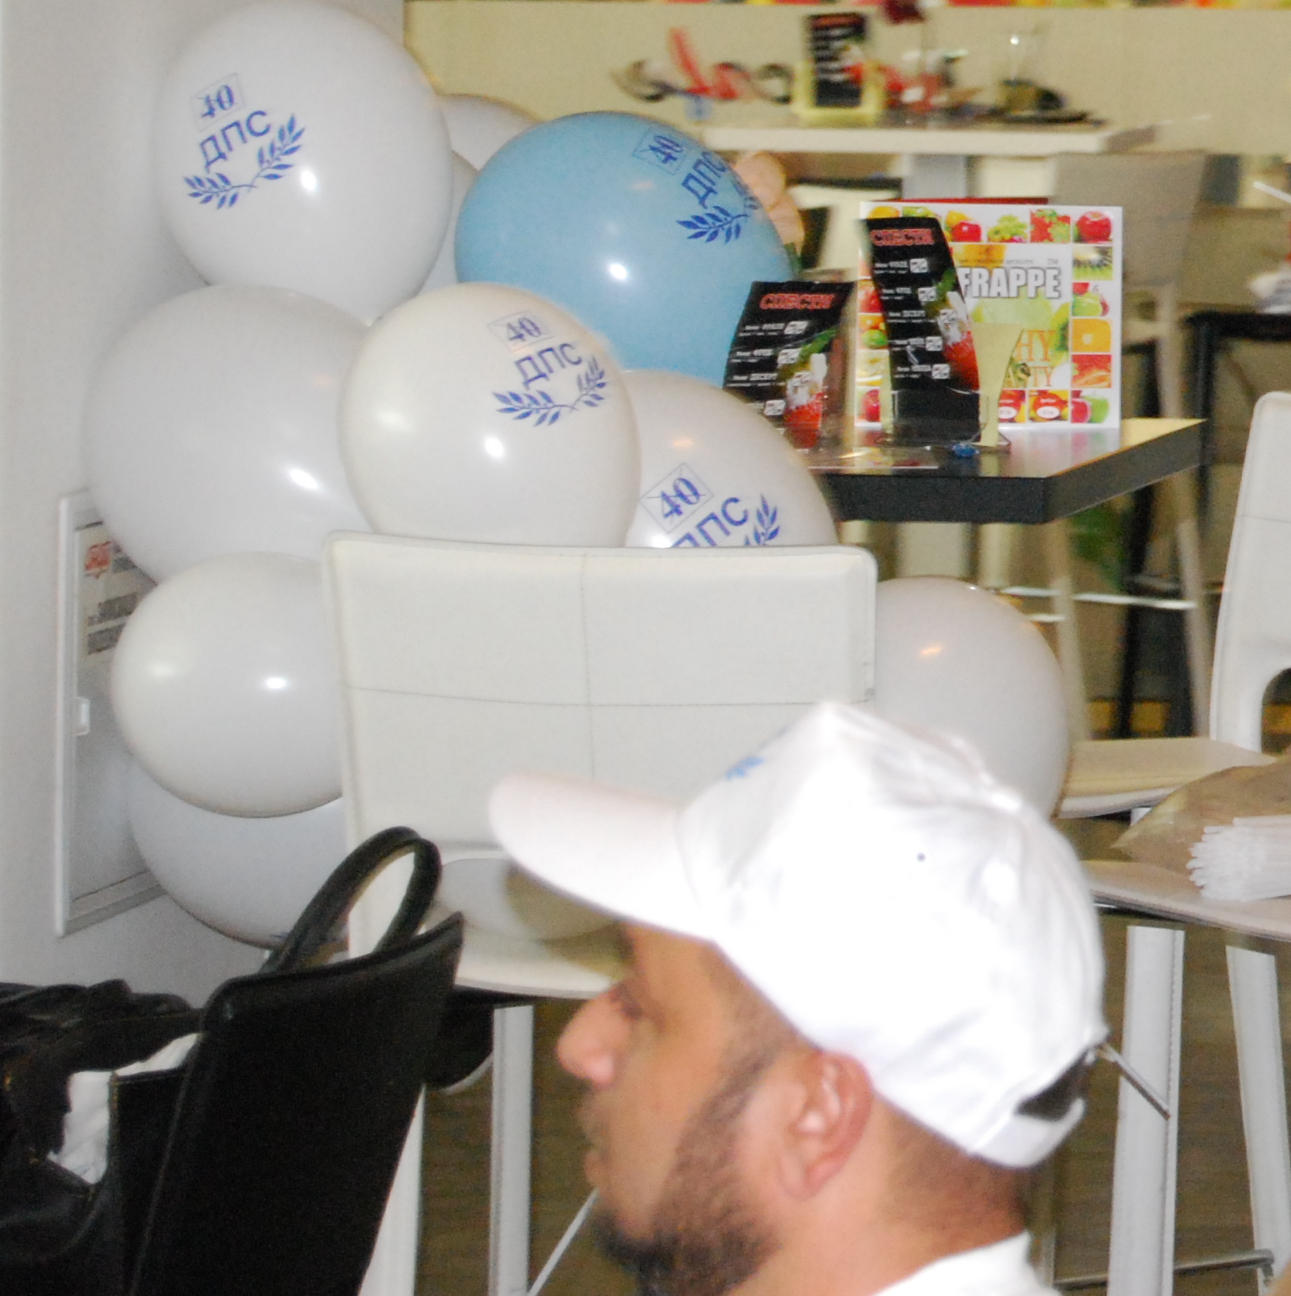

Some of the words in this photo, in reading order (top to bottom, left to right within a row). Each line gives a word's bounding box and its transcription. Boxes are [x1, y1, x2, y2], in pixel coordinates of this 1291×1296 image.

[201, 83, 236, 118] 40
[199, 110, 272, 174] ДПС
[681, 150, 727, 209] ДПС
[956, 266, 1062, 300] FRAPPE
[507, 316, 541, 342] 40
[514, 343, 583, 391] ДПС
[660, 477, 700, 519] 40
